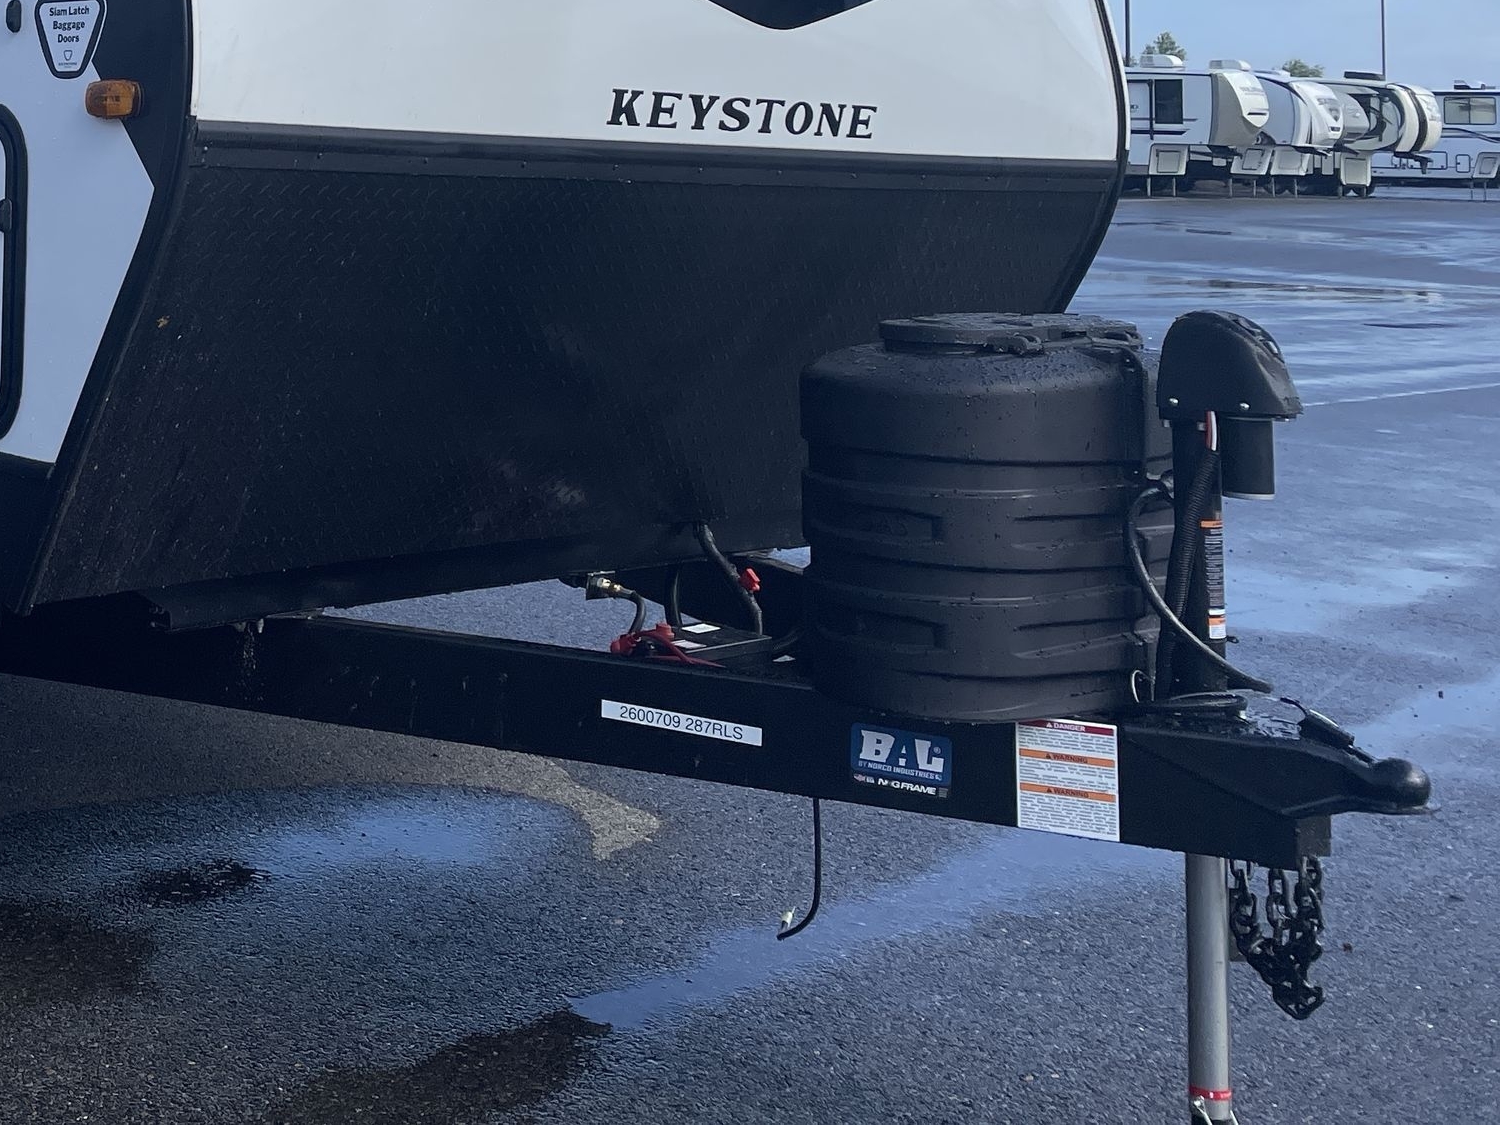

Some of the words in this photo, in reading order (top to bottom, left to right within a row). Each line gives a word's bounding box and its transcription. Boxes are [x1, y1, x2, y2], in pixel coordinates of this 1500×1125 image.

[68, 5, 90, 15] Latch
[52, 21, 86, 31] Baggage
[57, 34, 80, 43] Doors
[606, 88, 878, 139] KEYSTONE
[620, 705, 681, 728] 2600709
[685, 717, 743, 740] 287RLS
[1053, 722, 1086, 732] DANGER
[860, 729, 945, 773] BAL
[1053, 754, 1088, 764] WARNING
[868, 763, 892, 772] NORCO
[893, 766, 935, 780] INDUSTRIES
[1053, 789, 1089, 798] WARNING
